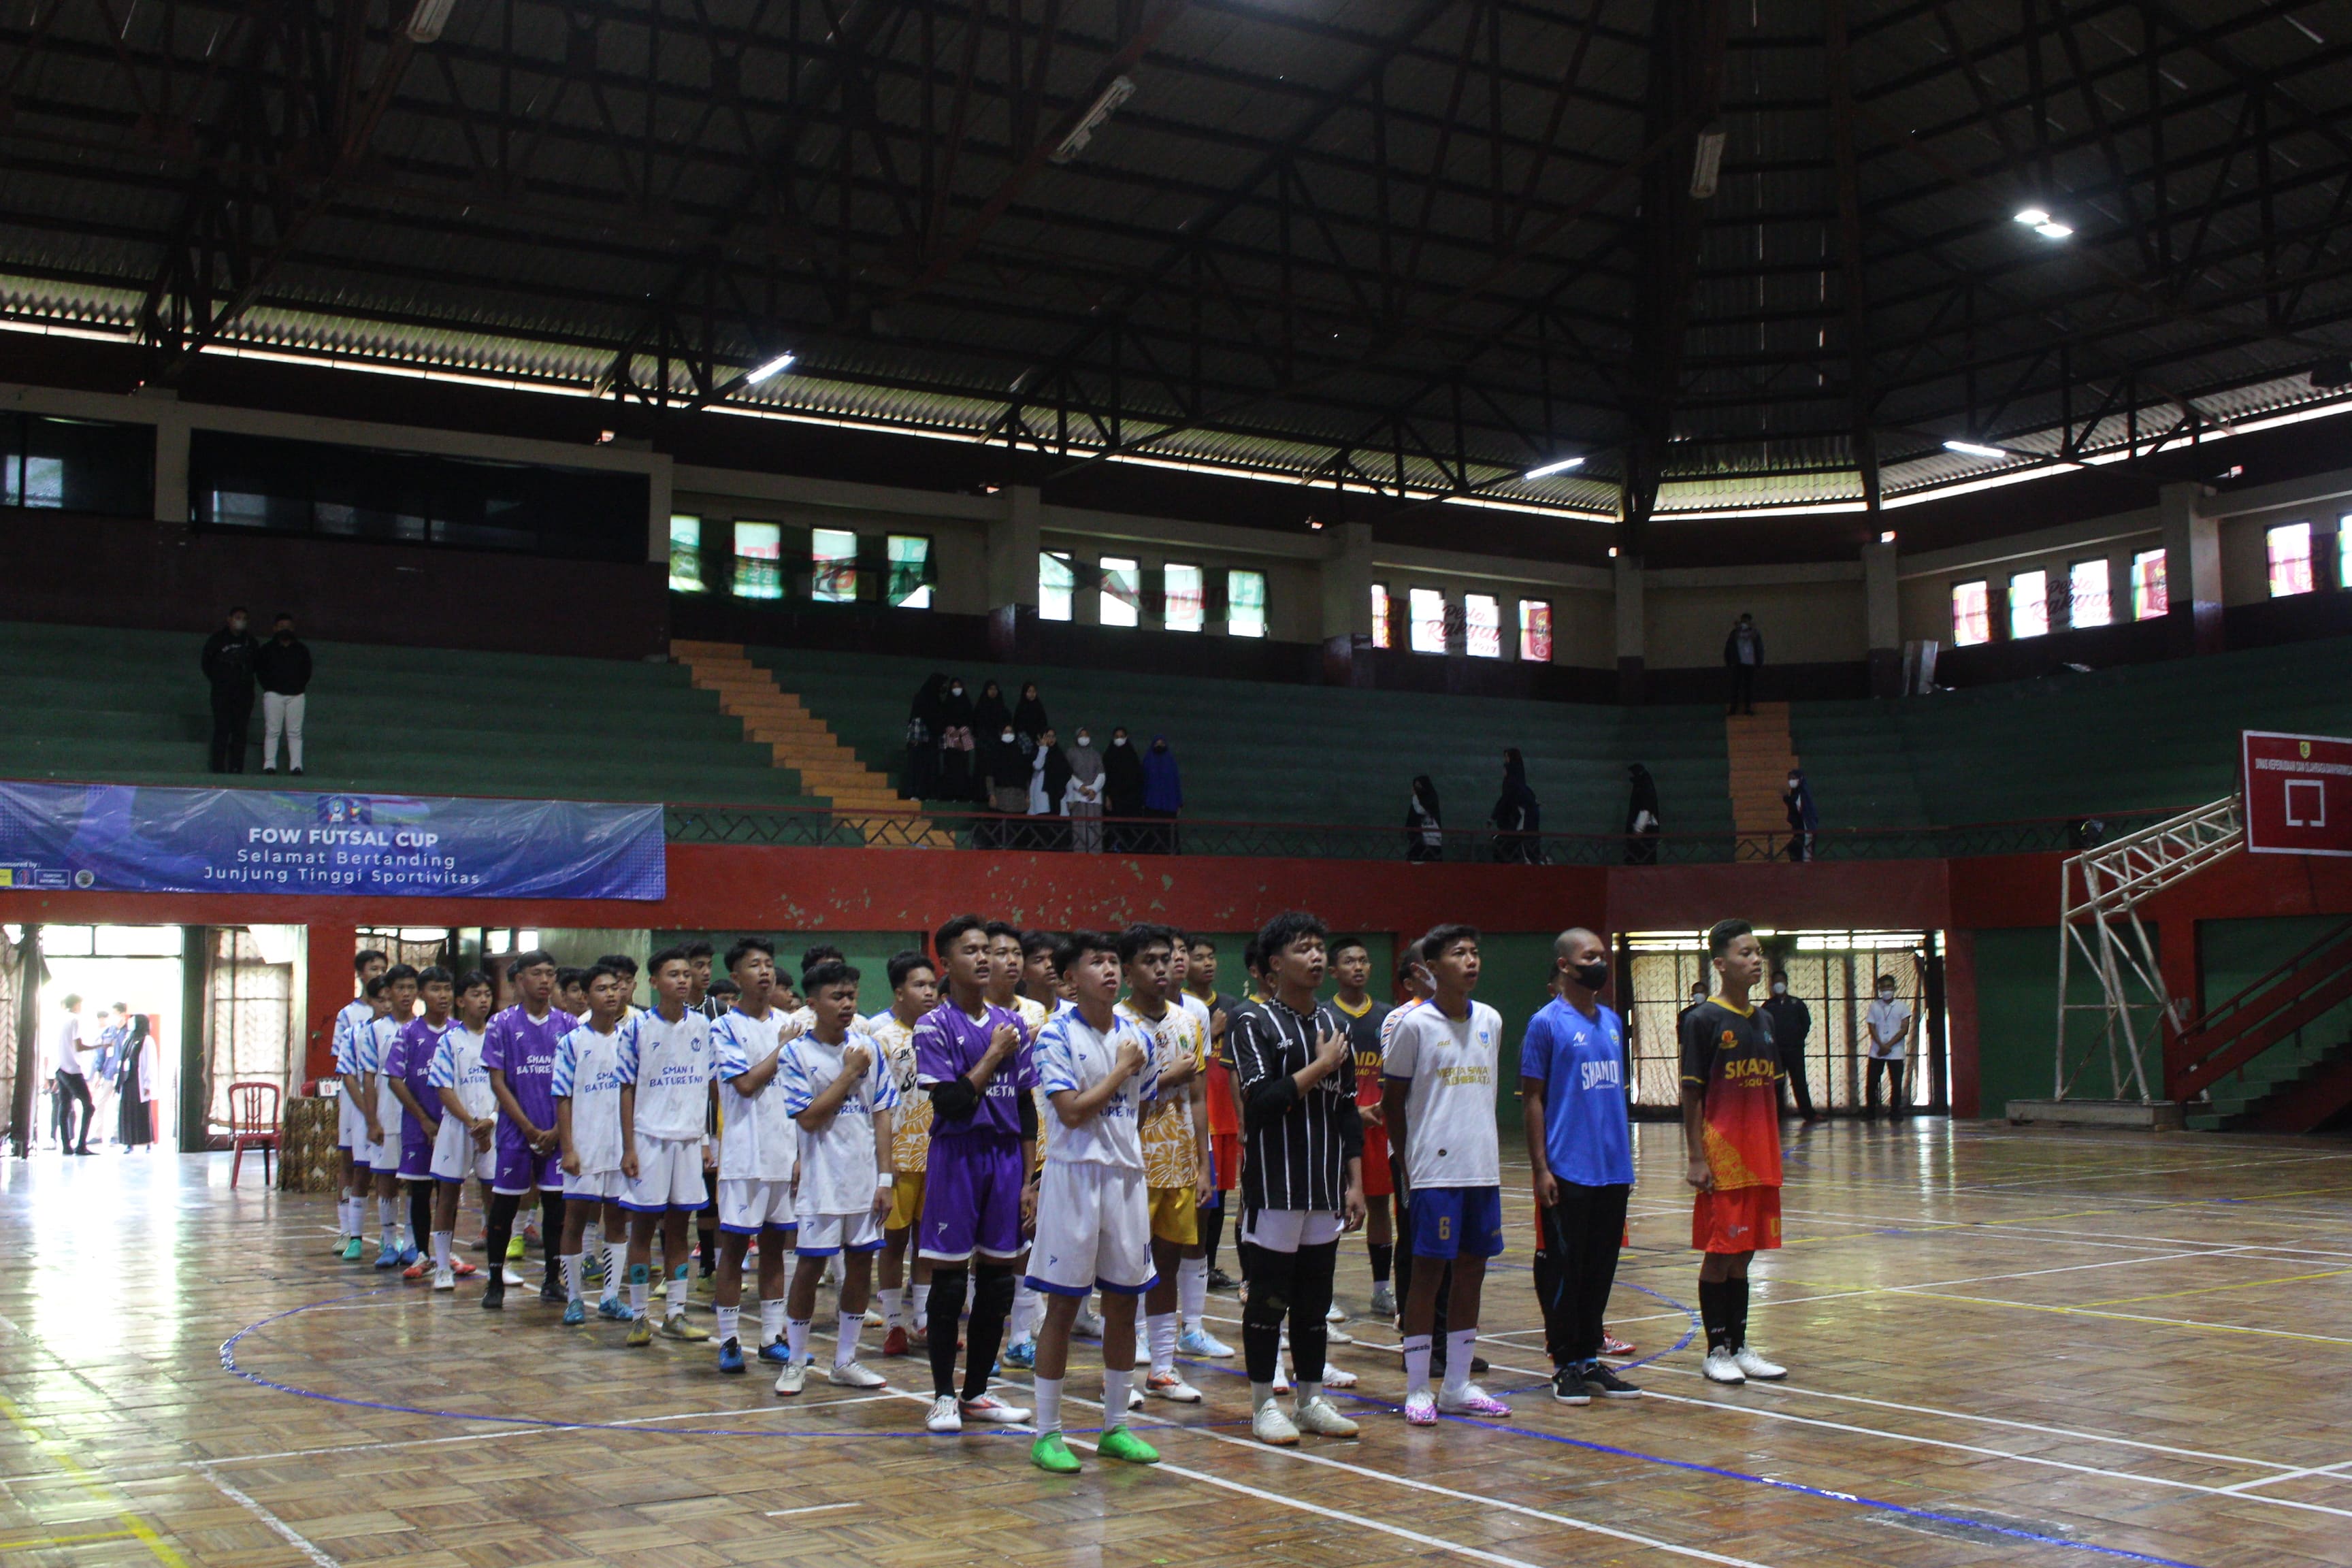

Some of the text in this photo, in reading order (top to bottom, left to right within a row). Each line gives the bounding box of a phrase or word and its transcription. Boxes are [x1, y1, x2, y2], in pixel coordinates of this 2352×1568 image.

[249, 828, 438, 847] FOW FUTSAL CUP
[237, 849, 455, 869] Selamat Bertanding
[204, 866, 479, 885] Junjung Tinggi Sportivitas
[662, 1066, 687, 1075] SMAN
[1439, 1216, 1450, 1240] 6
